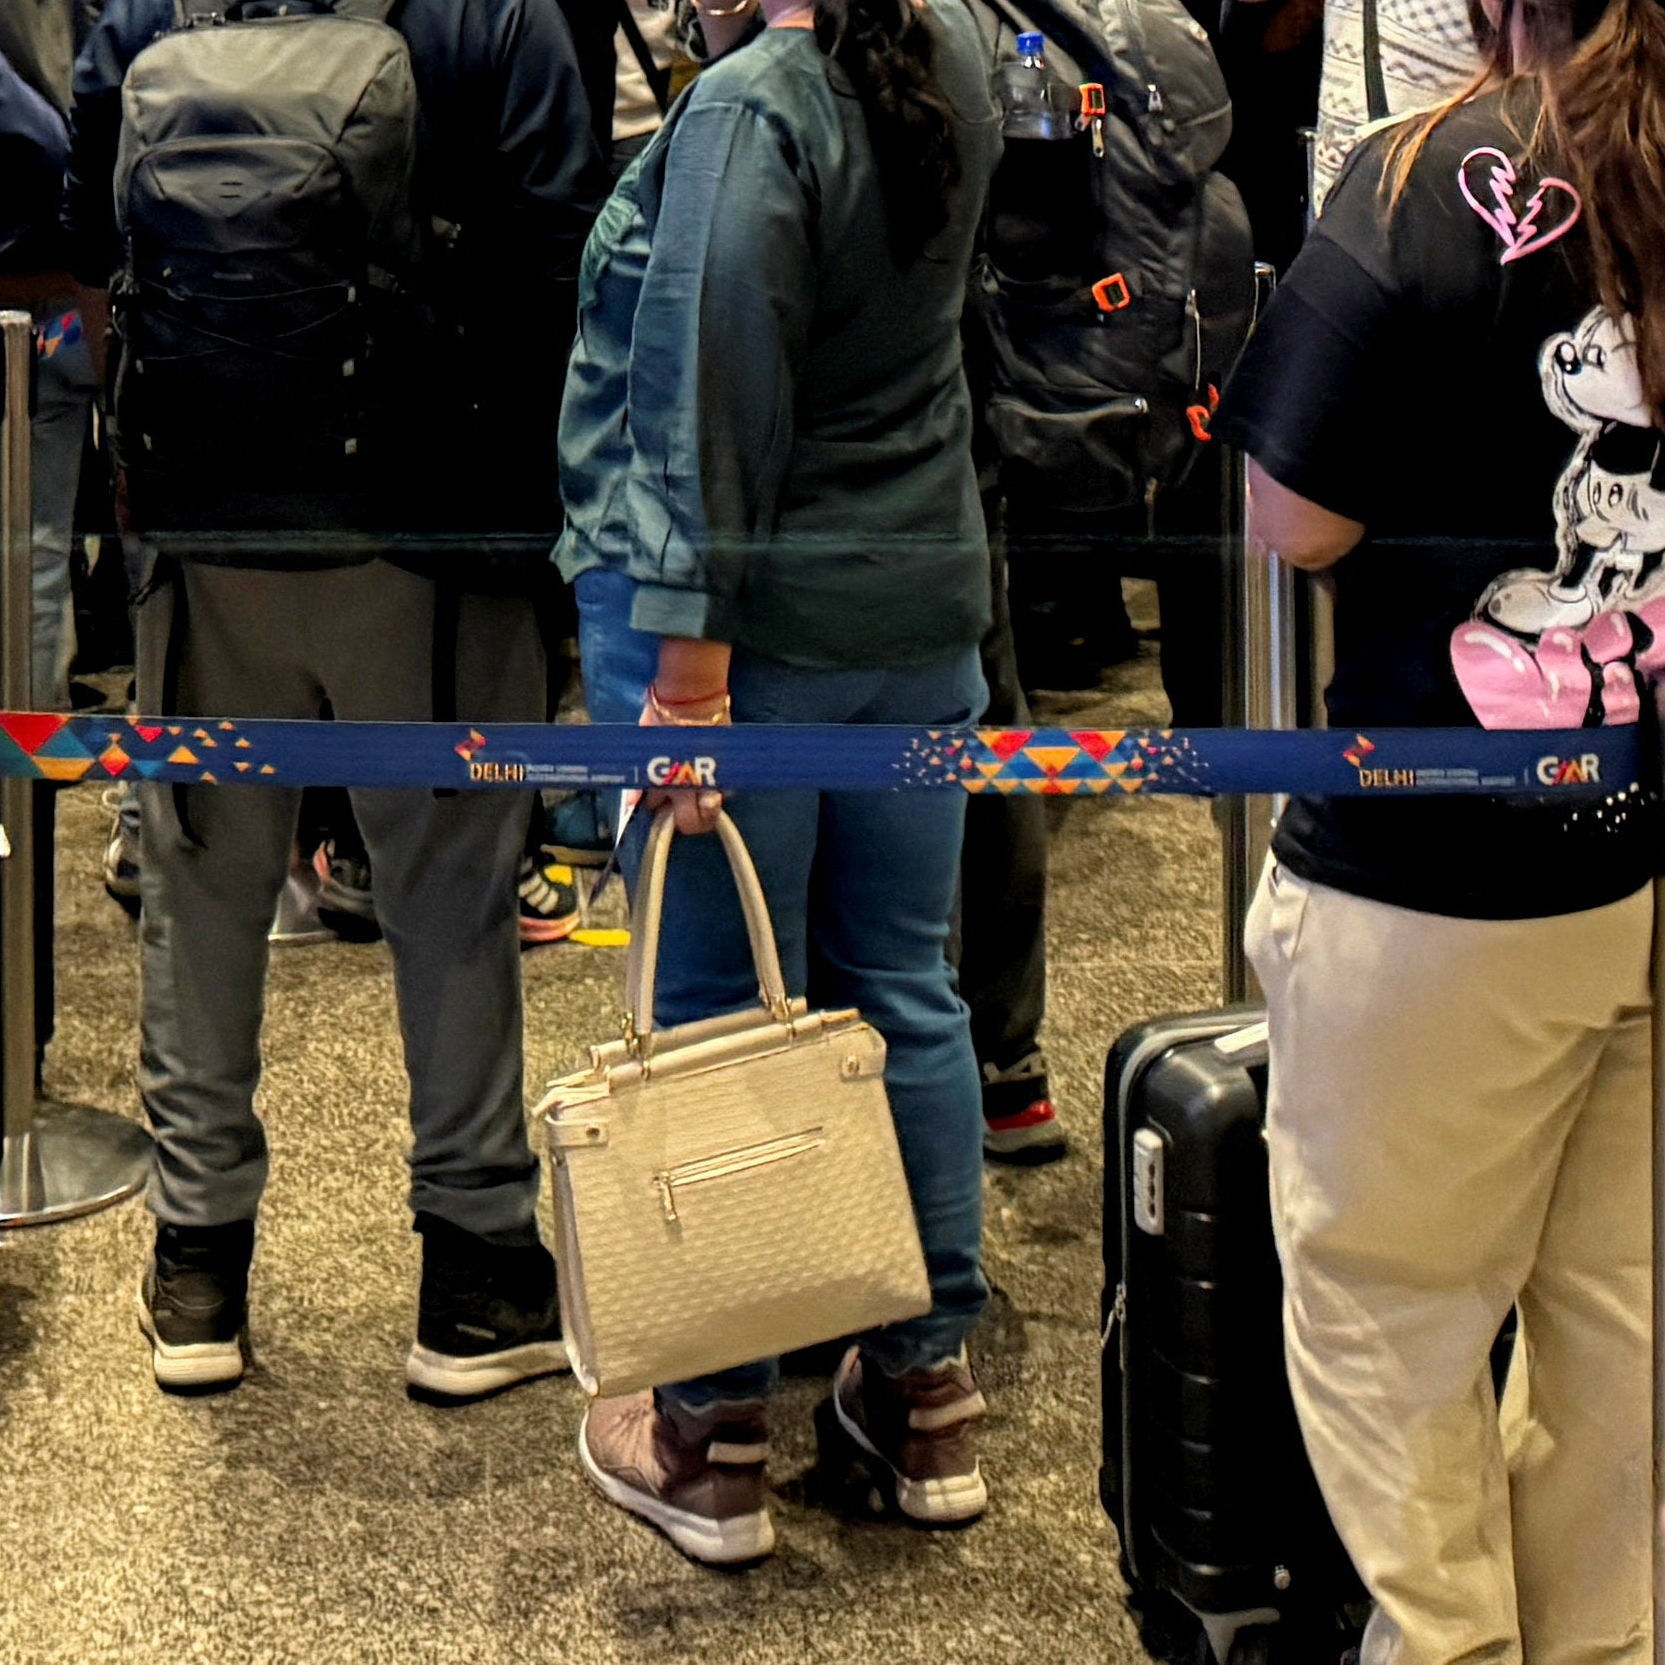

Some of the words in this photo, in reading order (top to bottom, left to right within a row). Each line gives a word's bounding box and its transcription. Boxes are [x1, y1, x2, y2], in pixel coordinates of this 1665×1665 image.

[469, 762, 525, 783] DELHI
[646, 755, 718, 786] GMR
[1359, 768, 1415, 787] DELHI
[1536, 752, 1601, 787] GMR
